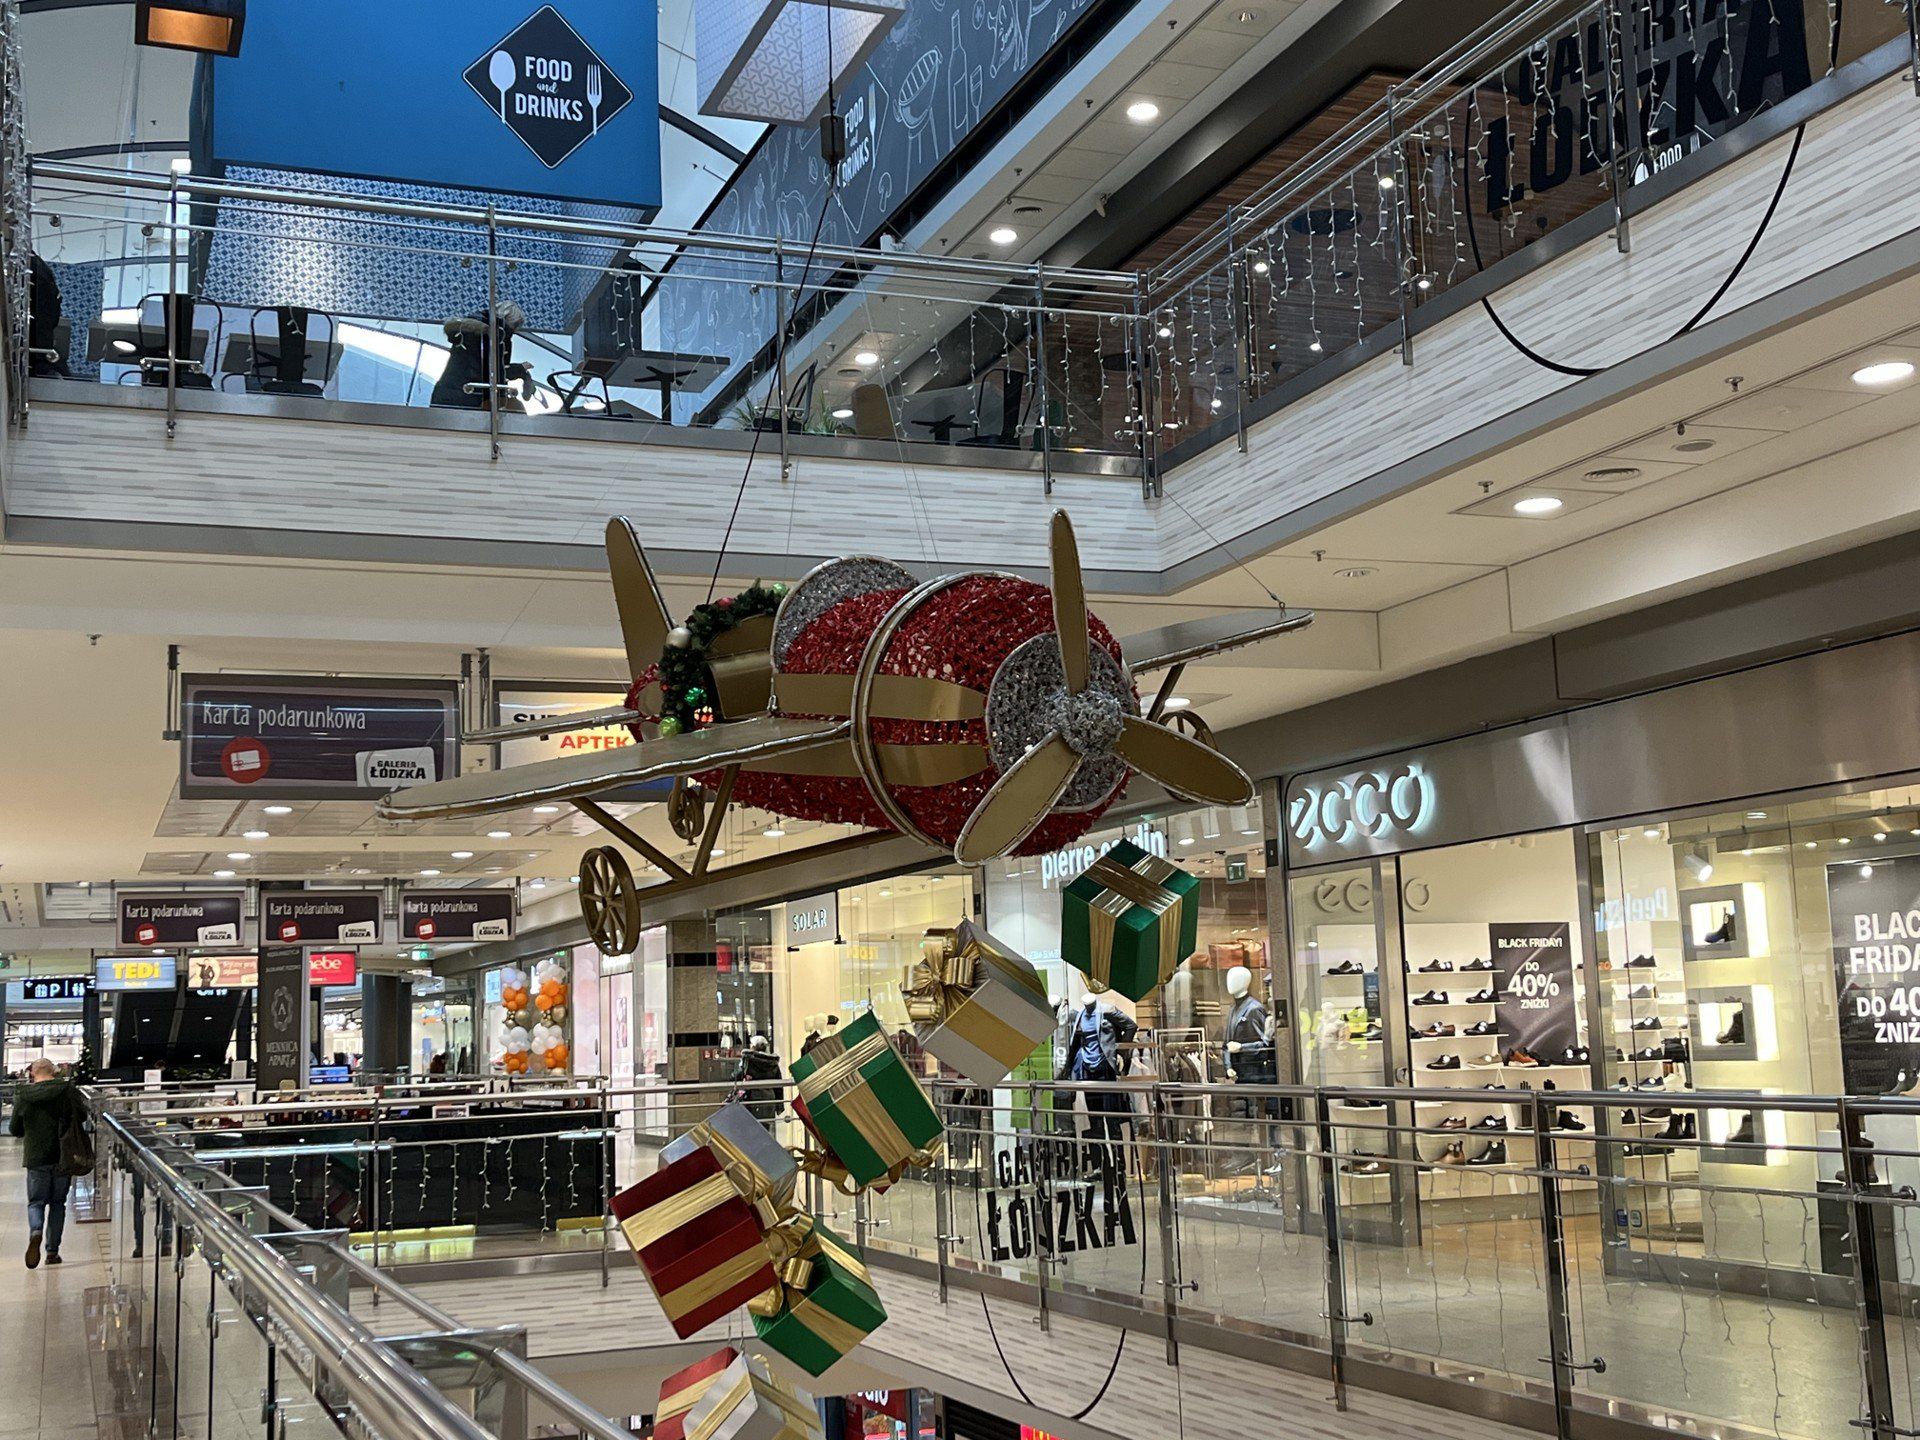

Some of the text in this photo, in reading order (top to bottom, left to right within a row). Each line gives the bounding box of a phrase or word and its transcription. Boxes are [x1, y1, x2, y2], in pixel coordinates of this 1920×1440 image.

[525, 56, 573, 82] FOOD
[536, 82, 559, 94] and
[515, 92, 583, 122] DRINKS
[845, 96, 864, 139] FOOD
[842, 136, 870, 188] DRINKS
[203, 701, 366, 734] Karta podarunkowa
[370, 767, 427, 780] ŁÓDZKA
[377, 760, 418, 769] GALERIA
[1288, 764, 1436, 849] ecco
[1041, 844, 1096, 889] pierre
[126, 904, 204, 922] Karta podarunkowa
[269, 902, 344, 919] Karta podarunkowa
[407, 900, 478, 916] Karta podarunkowa
[793, 909, 827, 933] SOLAR
[1498, 937, 1563, 949] BLACK FRIDAY!
[112, 962, 161, 980] TEDi
[1525, 961, 1540, 972] DO
[1507, 973, 1560, 998] 40%
[1520, 997, 1549, 1010] ZNIŻKI
[1856, 996, 1887, 1018] DO
